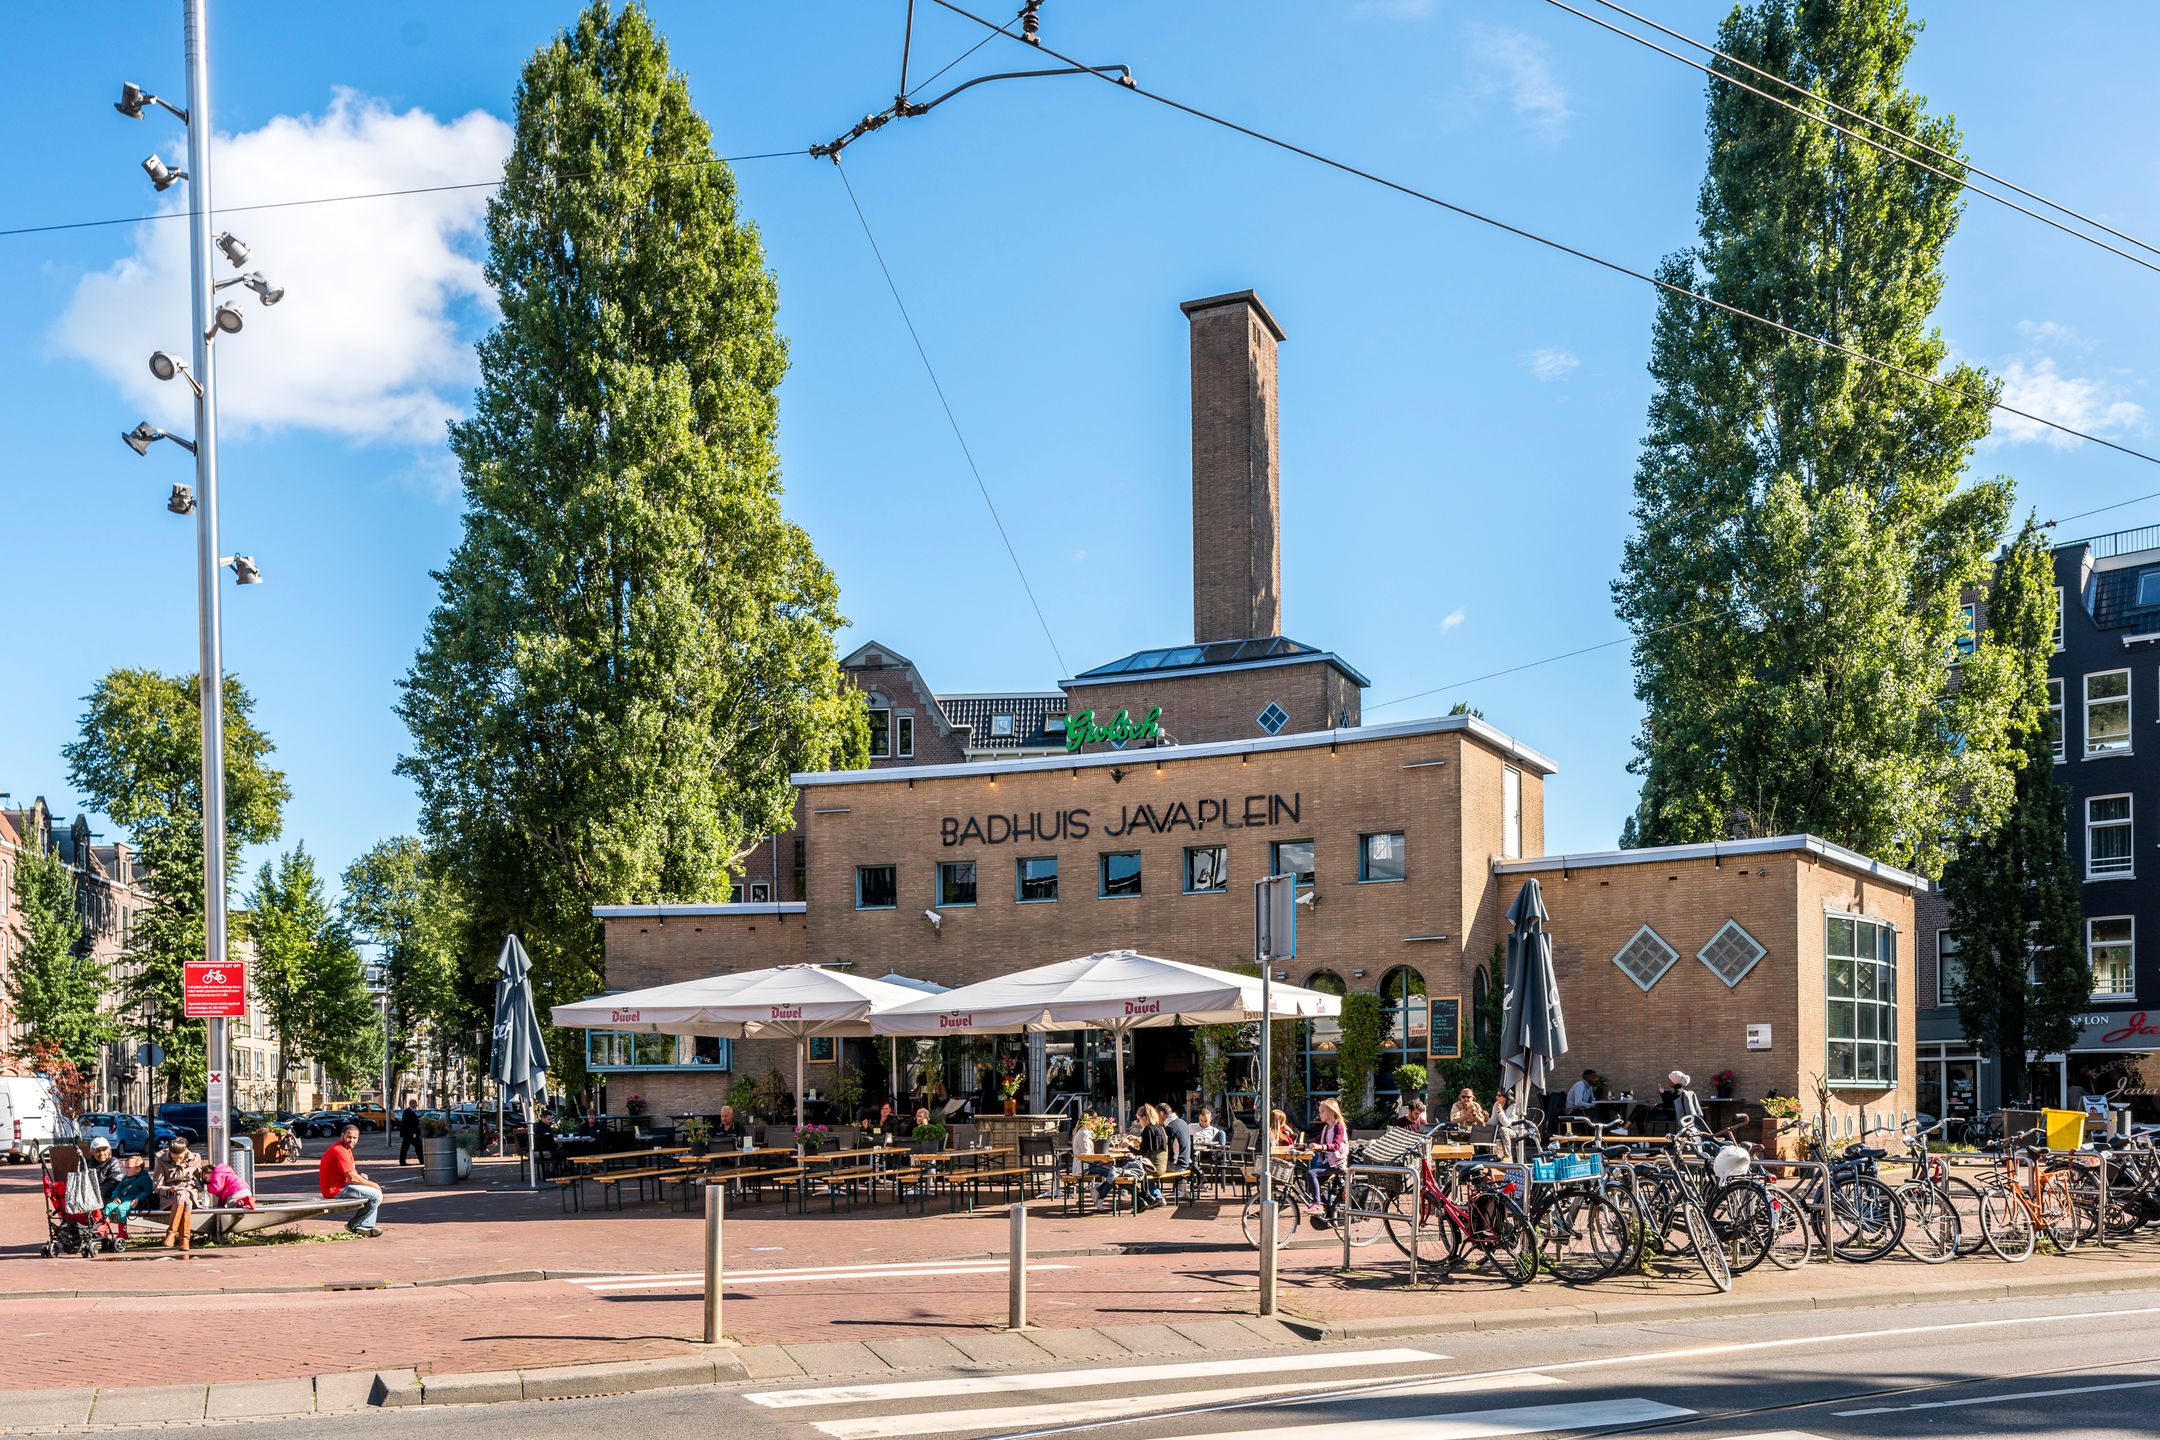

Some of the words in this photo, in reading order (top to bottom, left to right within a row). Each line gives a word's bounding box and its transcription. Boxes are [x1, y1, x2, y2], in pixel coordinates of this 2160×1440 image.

[1064, 706, 1161, 751] Grolsch
[941, 808, 1091, 847] BADHUIS
[1104, 792, 1299, 836] JAVAPLEIN
[771, 1006, 802, 1019] Duvel
[1124, 1000, 1160, 1014] Duvel
[611, 1010, 640, 1022] Duvel
[939, 1013, 972, 1027] Duvel
[2105, 1076, 2159, 1099] Java
